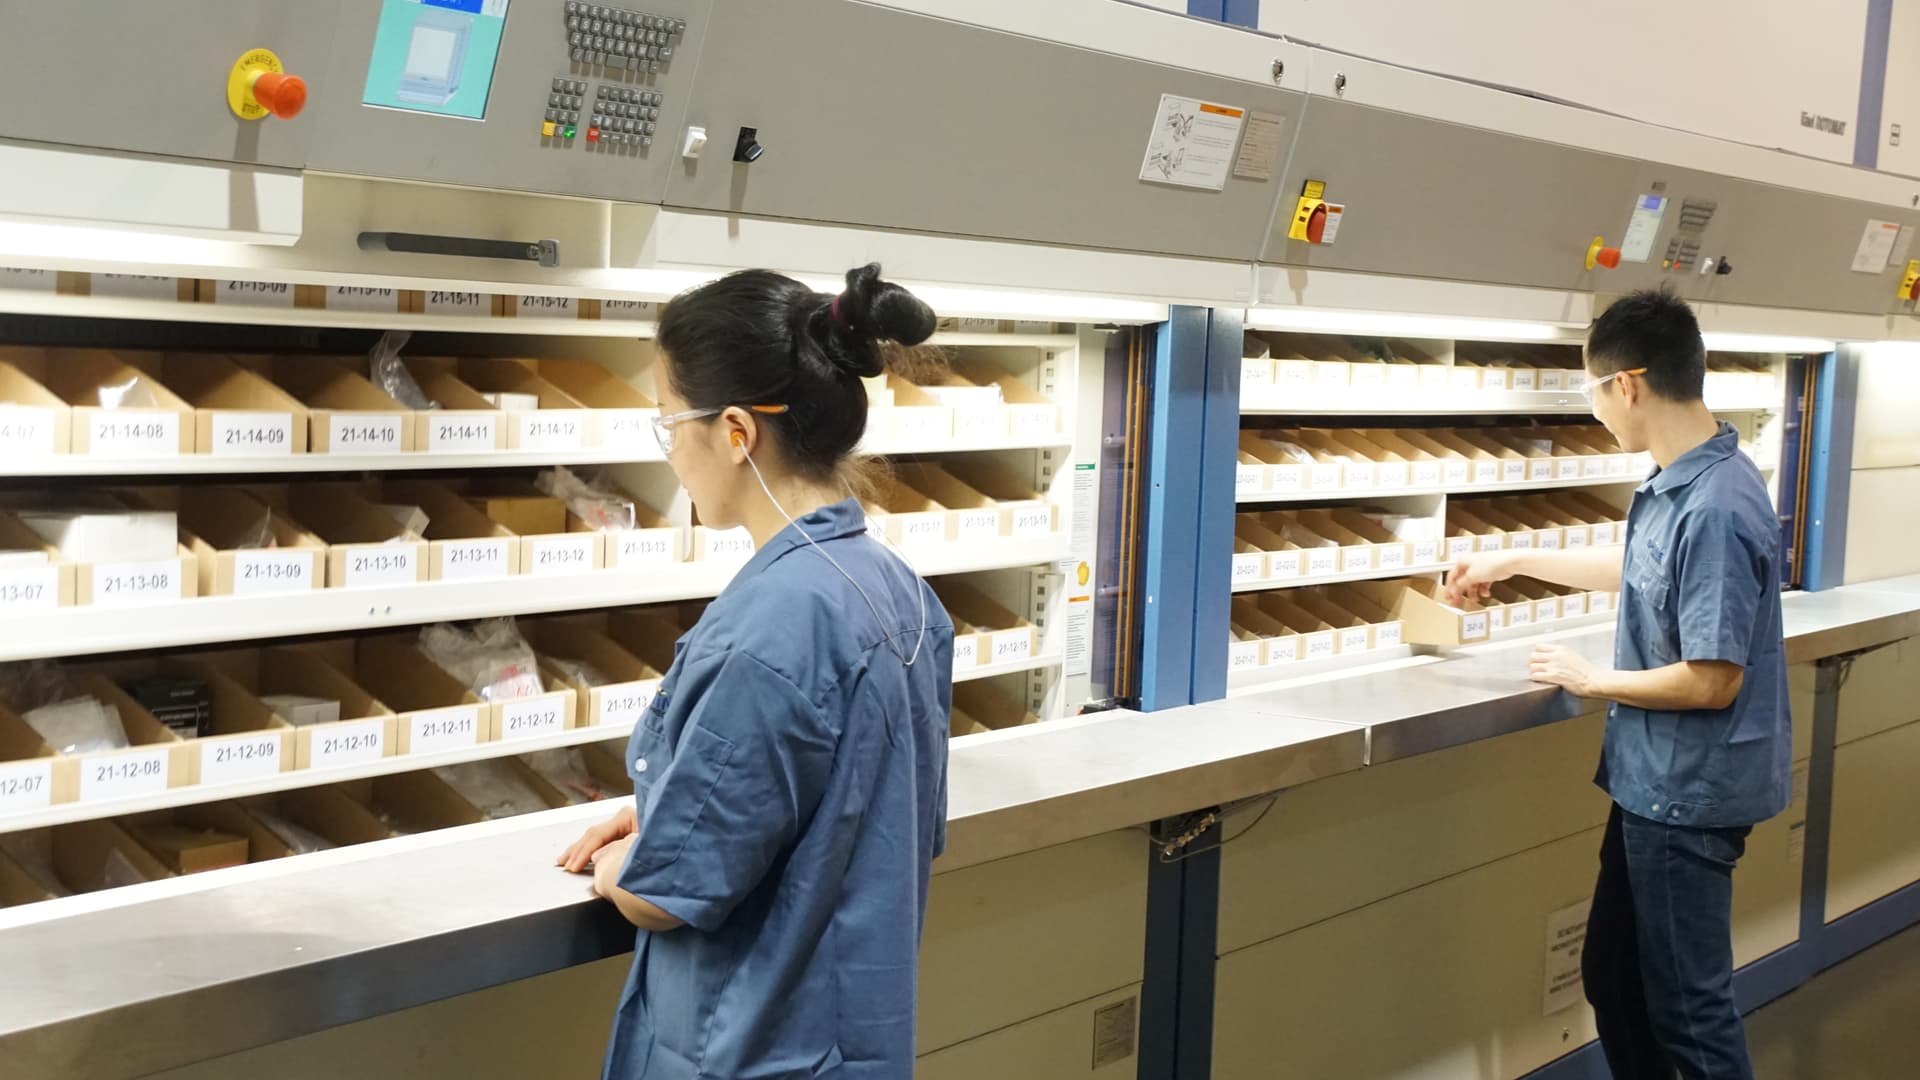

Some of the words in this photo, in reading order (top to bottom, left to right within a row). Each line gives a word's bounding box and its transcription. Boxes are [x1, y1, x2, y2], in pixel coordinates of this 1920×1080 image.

[431, 290, 480, 306] 21-15-11
[522, 295, 569, 309] 21-15-12
[100, 424, 163, 438] 21-14-08
[227, 429, 283, 443] 21-14-09
[342, 428, 394, 441] 21-14-10
[440, 426, 487, 440] 21-14-11
[530, 422, 575, 436] 21-14-12
[625, 540, 666, 555] 21-13-13
[451, 549, 497, 562] 21-13-11
[540, 550, 584, 563] 21-13-12
[355, 555, 406, 571] 21-13-10
[245, 564, 301, 577] 21-13-09
[105, 574, 168, 592] 21-13-08
[511, 712, 555, 729] 21-12-12
[423, 720, 470, 736] 21-12-11
[324, 734, 376, 753] 21-12-10
[216, 743, 273, 762] 21-12-09
[97, 760, 160, 781] 21-12-08
